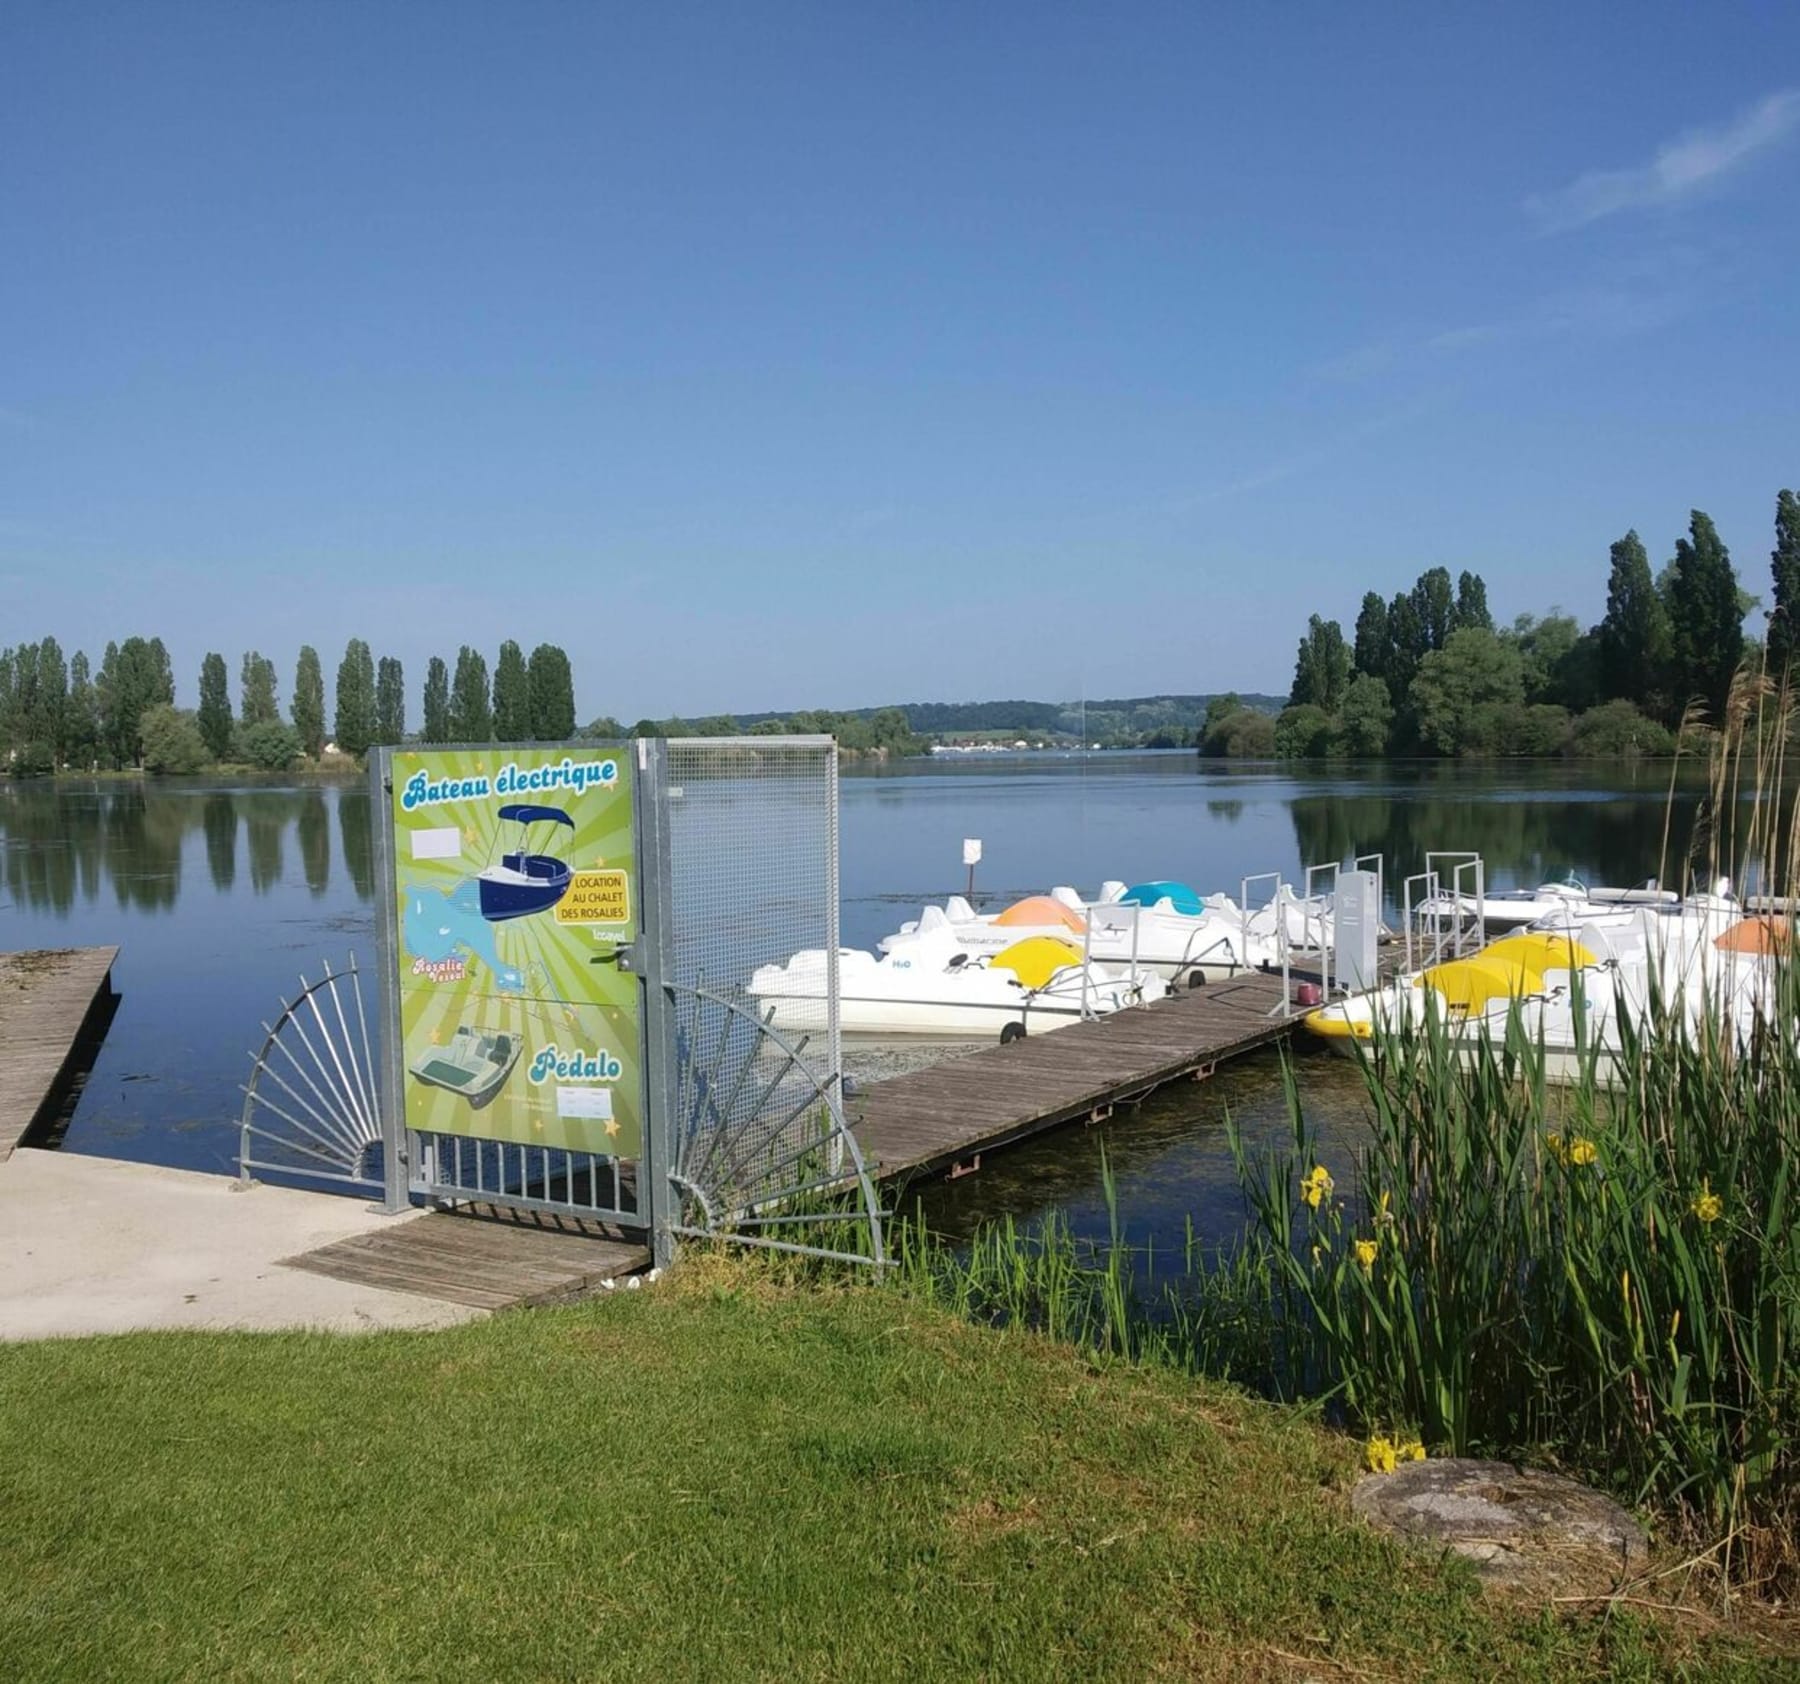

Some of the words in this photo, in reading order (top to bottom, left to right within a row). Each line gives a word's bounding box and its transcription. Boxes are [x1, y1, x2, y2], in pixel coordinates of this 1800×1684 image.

[402, 772, 490, 808] Bateau
[496, 760, 616, 792] électrique
[575, 877, 621, 889] LOCATION
[572, 893, 586, 904] AU
[588, 892, 623, 903] CHALET
[561, 908, 579, 919] DES
[580, 907, 625, 918] ROSALIES
[412, 956, 464, 975] Rosalie
[530, 1045, 621, 1083] Pédalo
